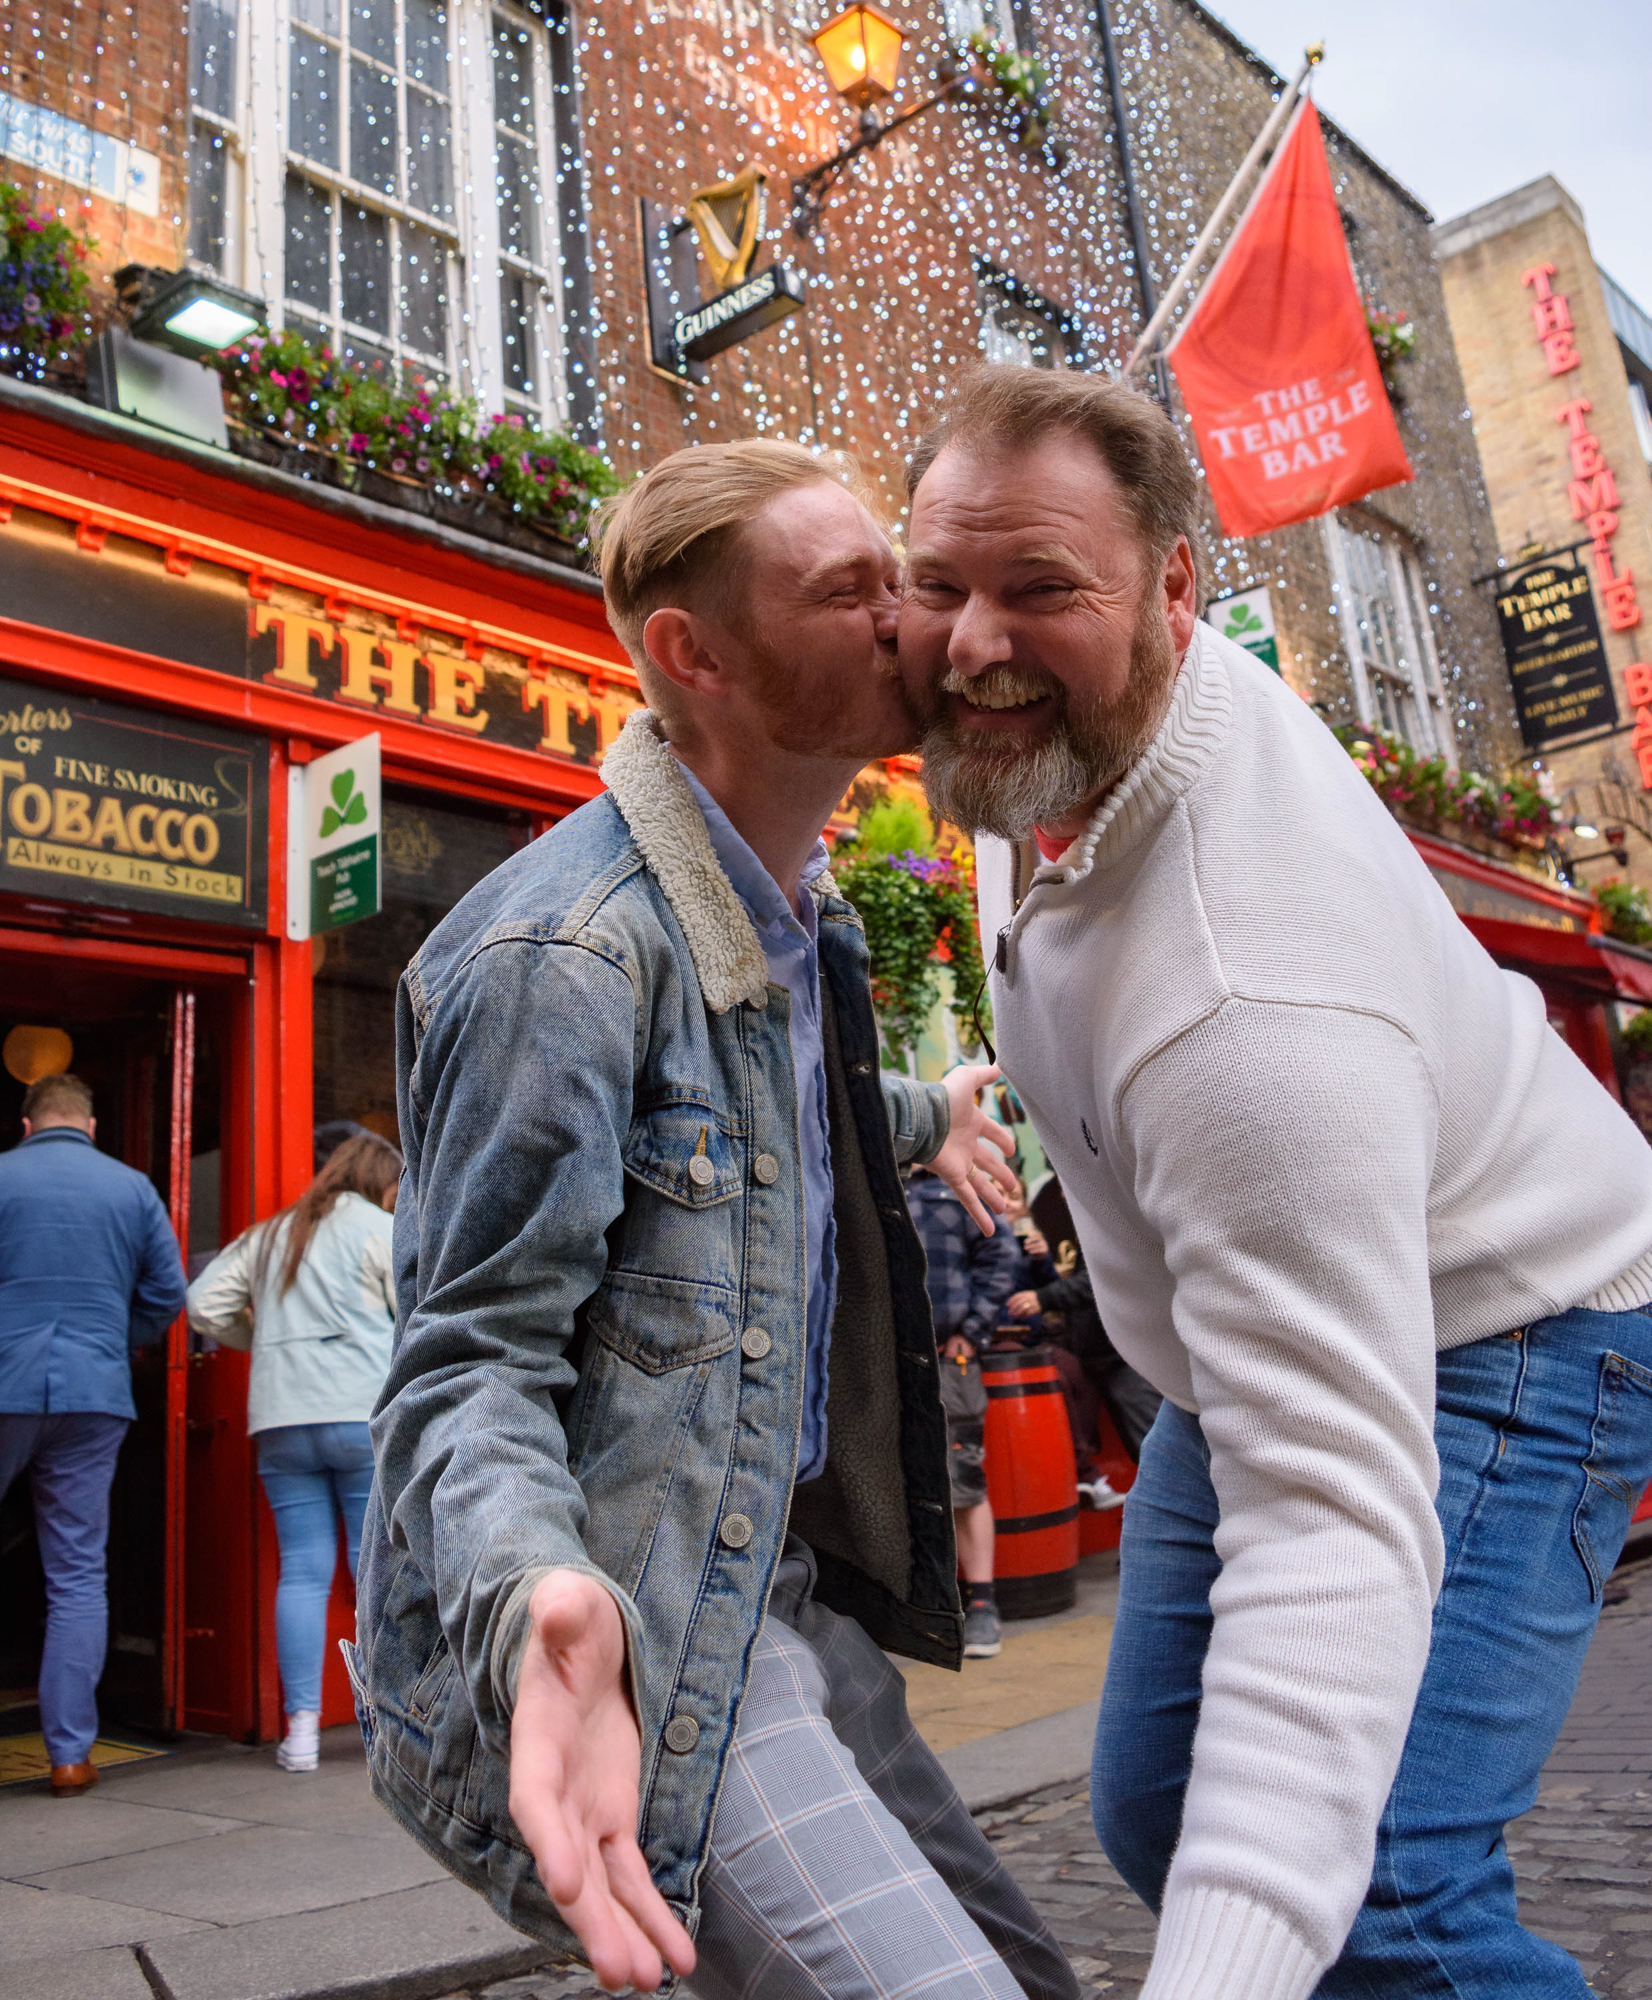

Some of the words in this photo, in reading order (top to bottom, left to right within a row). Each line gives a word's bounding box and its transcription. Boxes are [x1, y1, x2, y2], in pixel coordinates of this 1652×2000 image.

[675, 272, 775, 344] GUINNESS
[1208, 380, 1372, 459] TEMPLE
[1252, 377, 1324, 417] THE
[1260, 431, 1348, 481] BAR
[1521, 261, 1582, 375] THE
[1555, 397, 1642, 632] TEMPLE
[1498, 574, 1590, 618] TEMPLE
[1525, 568, 1556, 591] THE
[1521, 602, 1573, 632] BAR
[248, 604, 490, 736] THE
[14, 735, 43, 756] OF
[54, 755, 109, 787] FINE
[113, 767, 219, 809] SMOKING
[12, 839, 113, 876] Always
[128, 862, 152, 883] in
[163, 865, 238, 898] Stock
